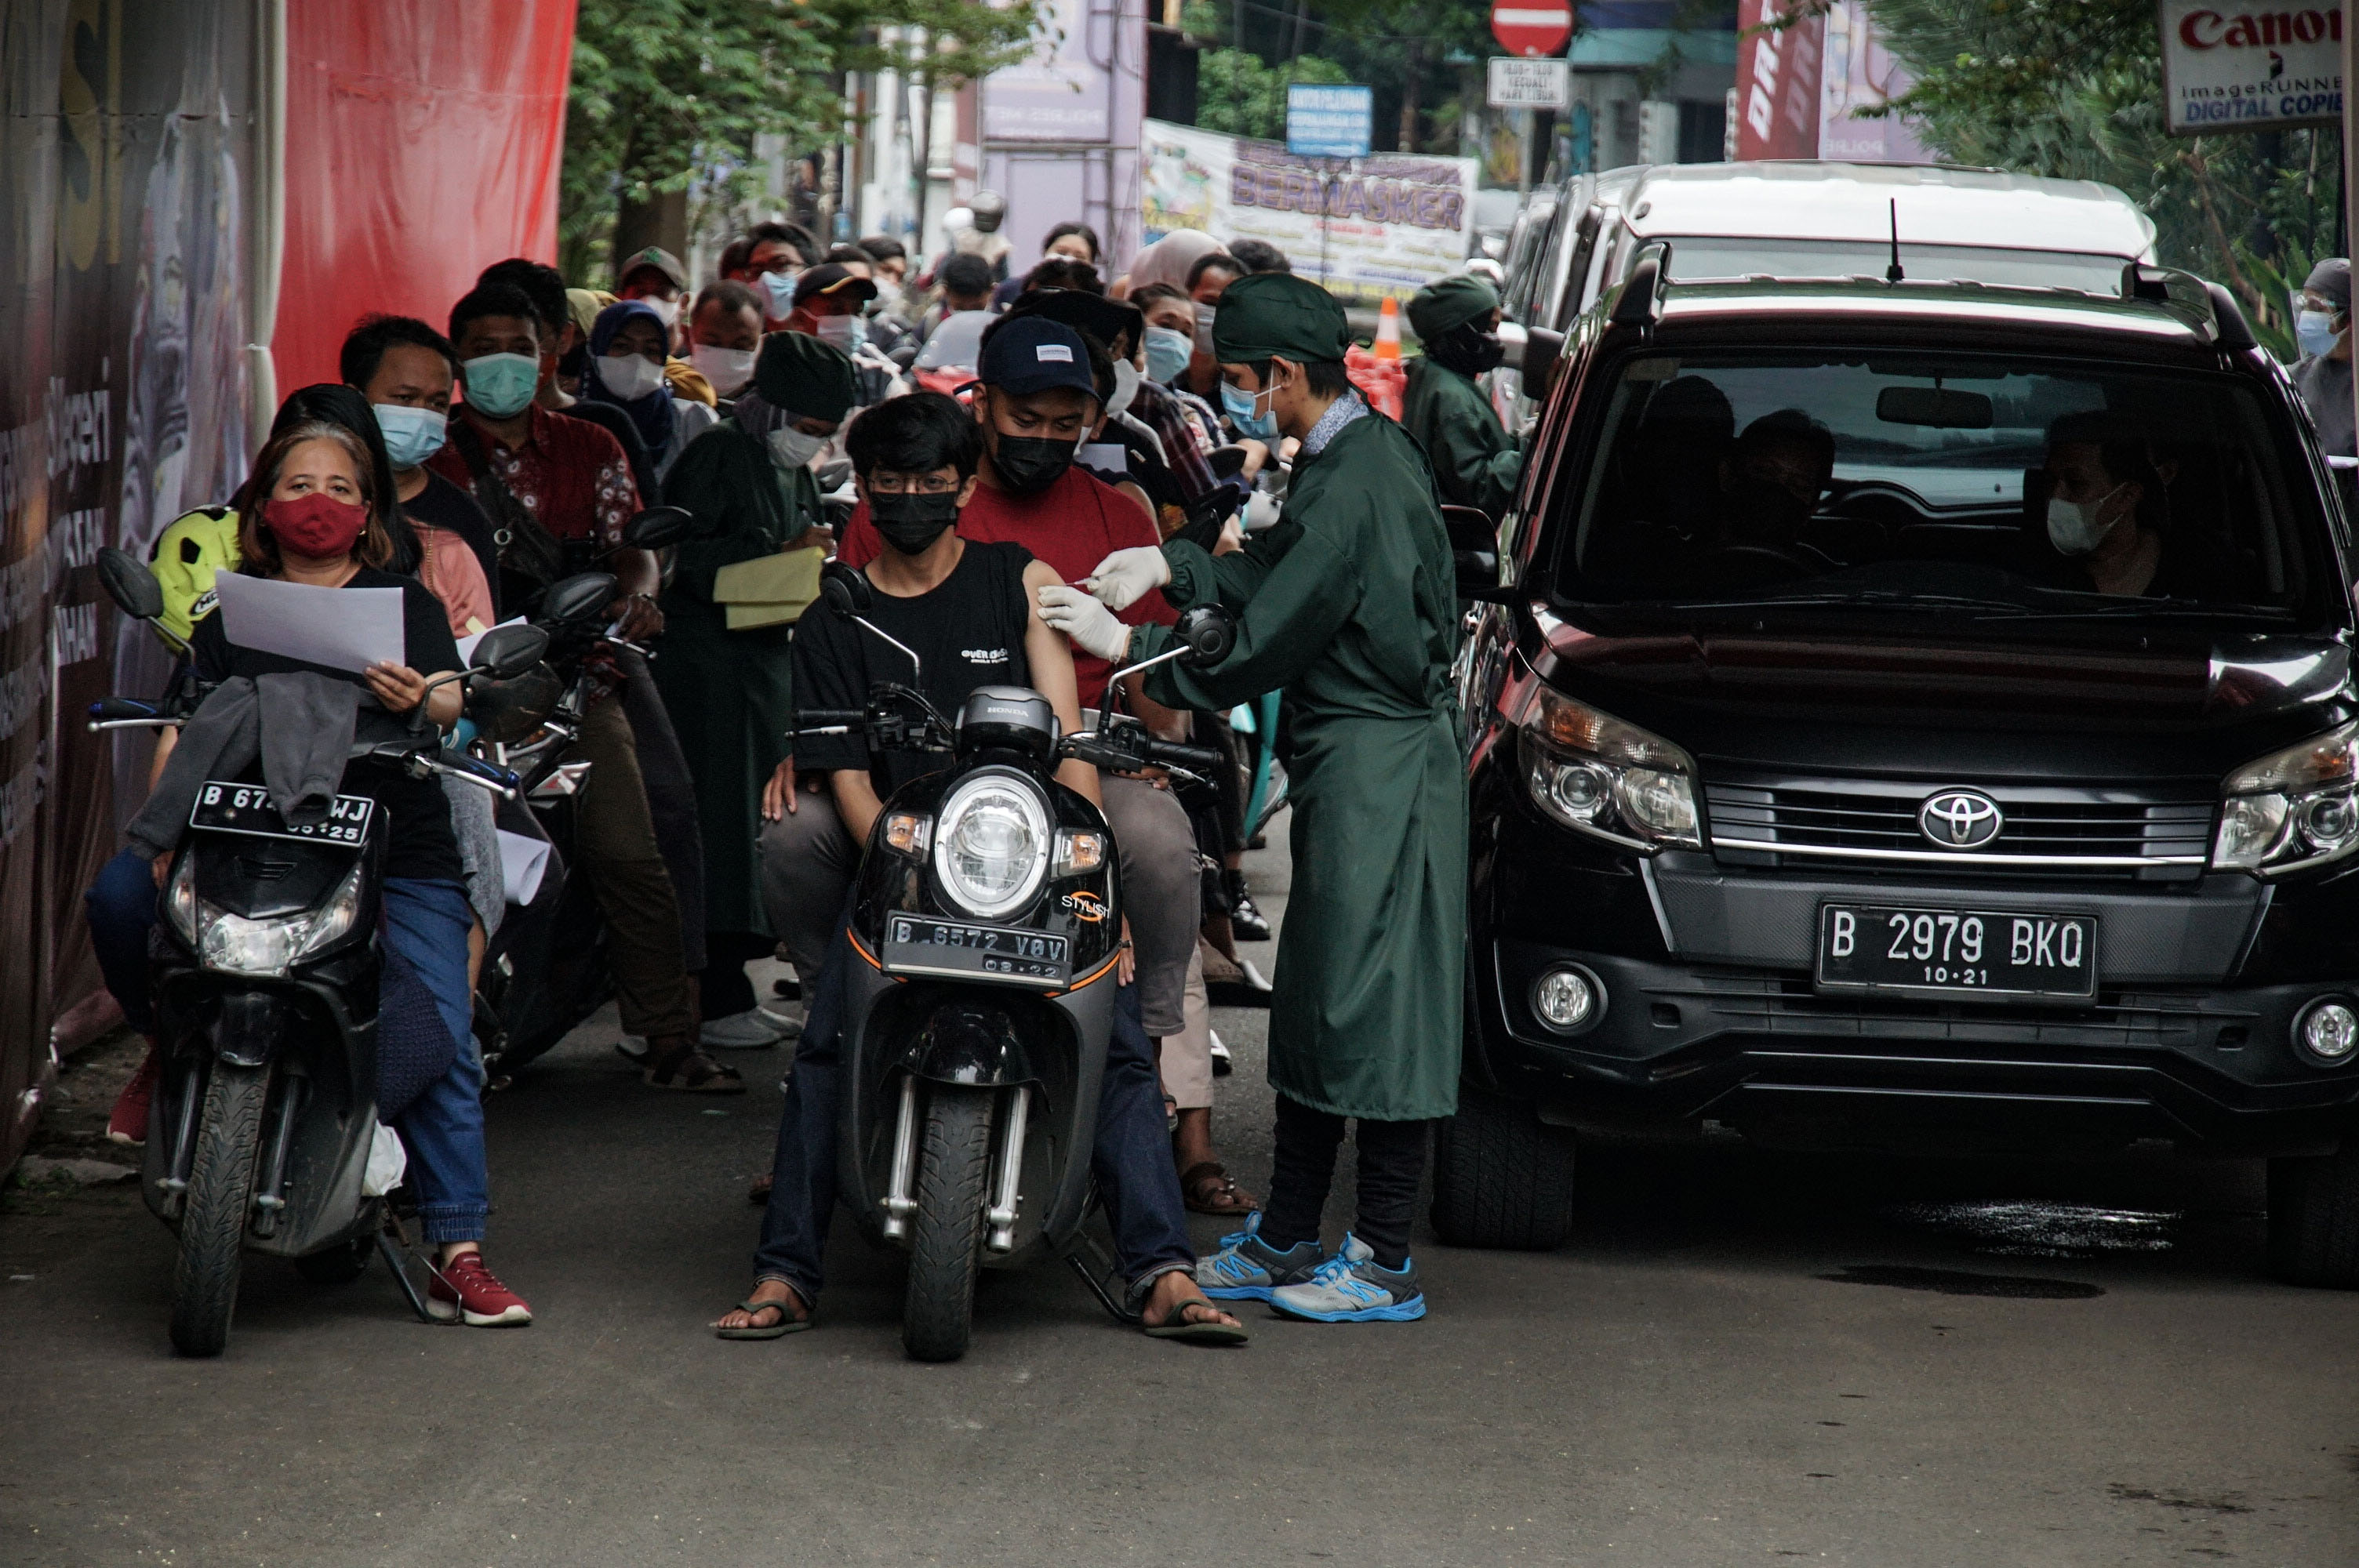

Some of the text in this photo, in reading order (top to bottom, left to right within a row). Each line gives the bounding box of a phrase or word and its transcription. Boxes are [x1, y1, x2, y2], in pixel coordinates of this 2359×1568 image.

[2181, 75, 2343, 98] imageRUNNE
[2185, 92, 2343, 122] DIGITAL COPIE
[1232, 165, 1466, 232] BERMASKER
[987, 706, 1029, 717] HONDA
[203, 786, 368, 822] B 67 WJ
[1061, 895, 1110, 920] STYLISH
[896, 921, 912, 944] B
[933, 925, 1000, 952] 6572
[1832, 910, 2083, 968] B 2979 BKQ
